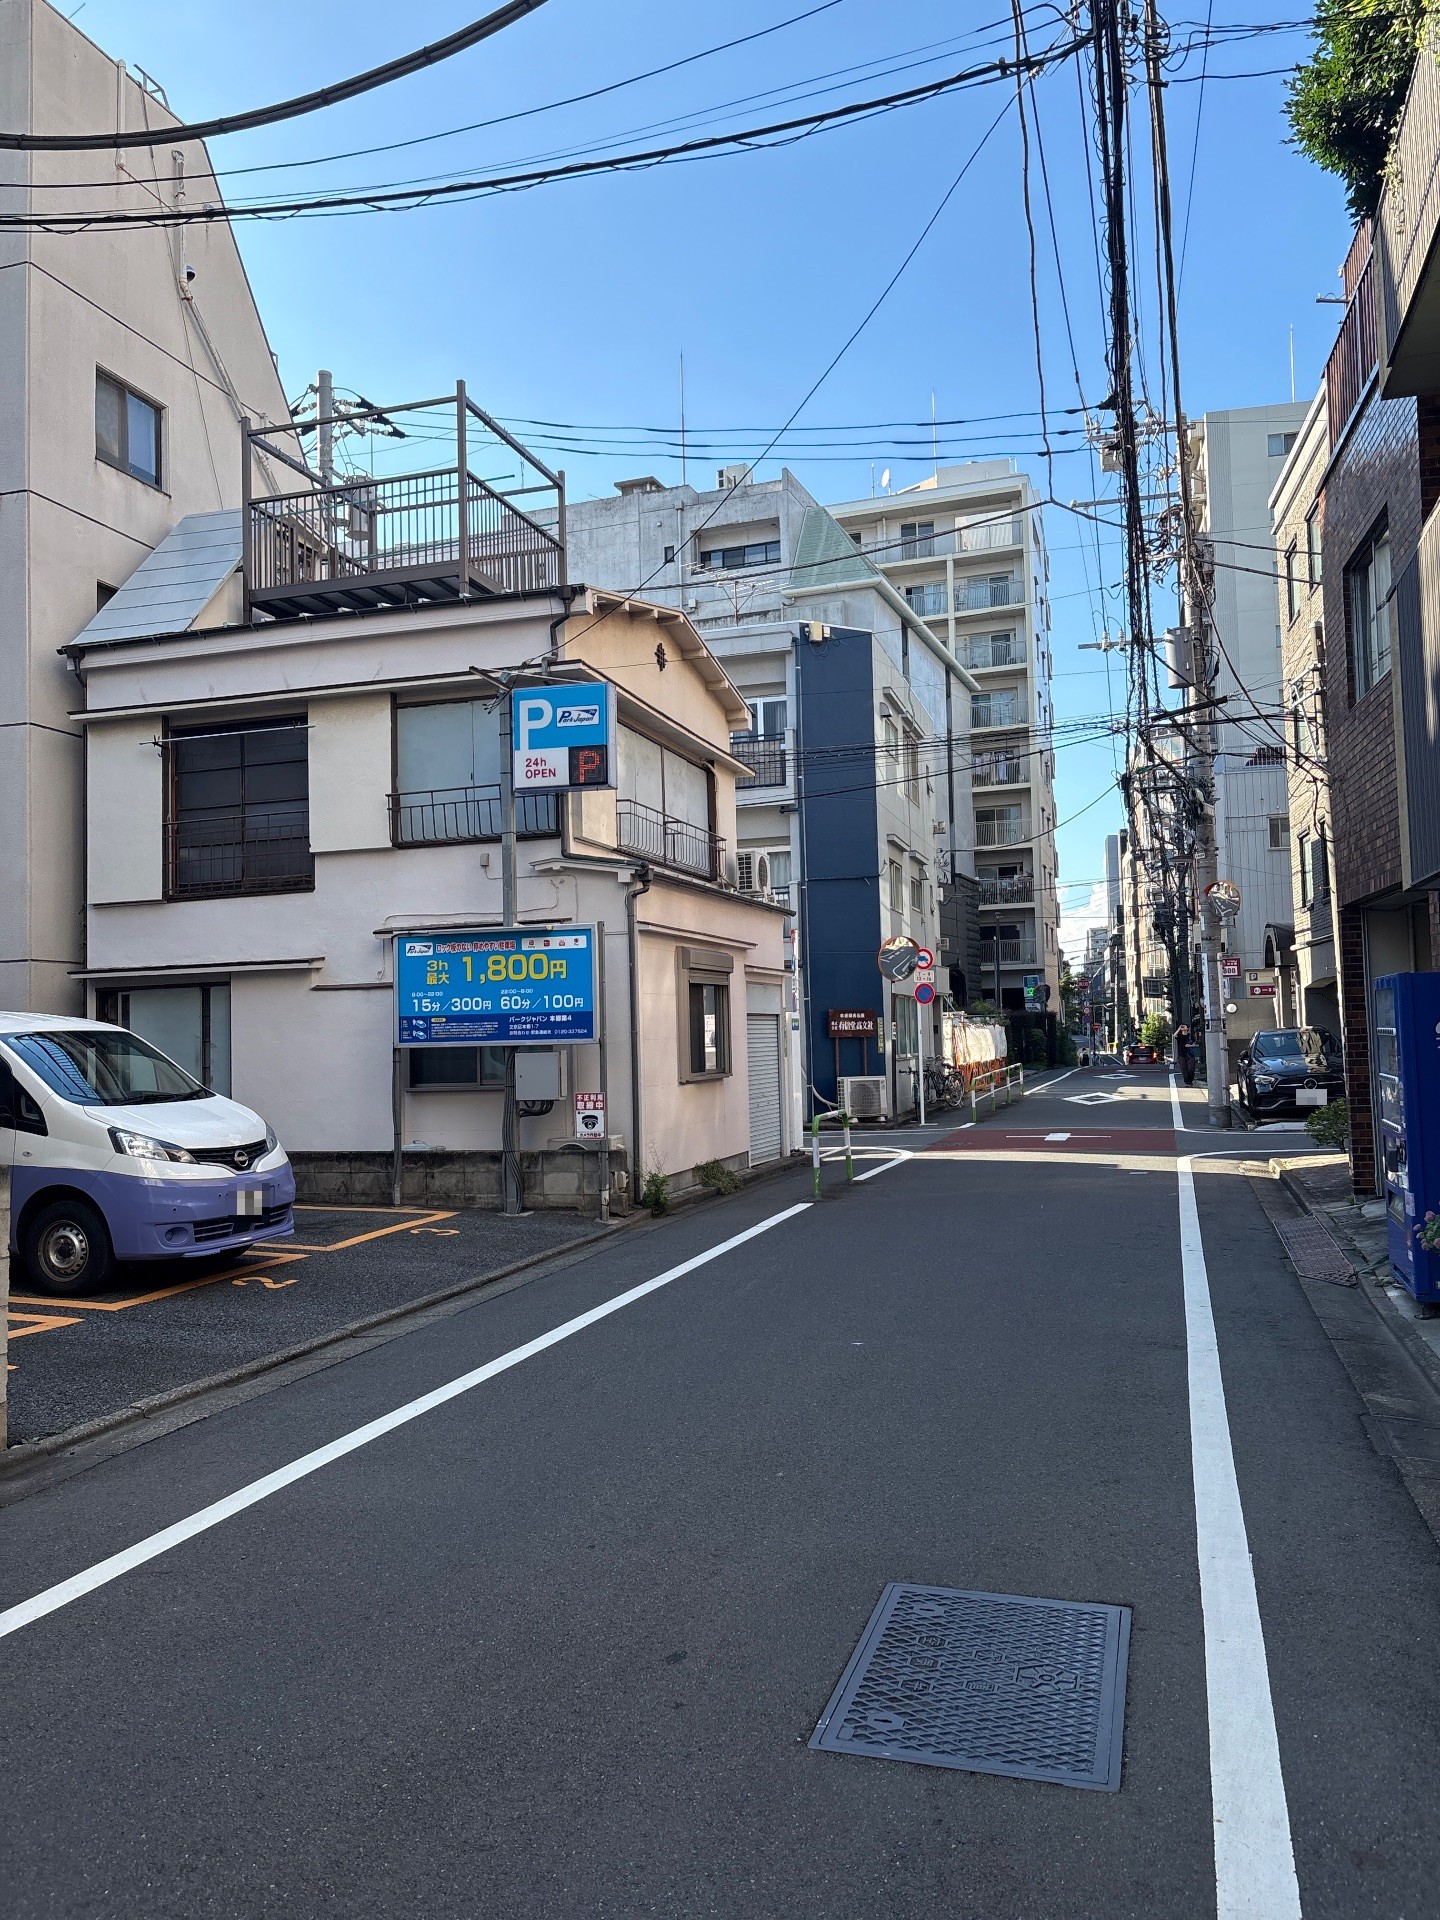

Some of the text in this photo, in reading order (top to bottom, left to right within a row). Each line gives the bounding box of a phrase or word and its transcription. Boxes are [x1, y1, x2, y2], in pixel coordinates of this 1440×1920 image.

[558, 710, 574, 724] Park
[519, 698, 553, 750] P
[525, 757, 547, 768] 24h
[578, 750, 600, 783] P
[525, 768, 556, 779] OPEN
[426, 959, 449, 971] 3h
[462, 953, 567, 984] 1,800円
[426, 972, 450, 985] 最大
[509, 1015, 548, 1023] パークジャパン
